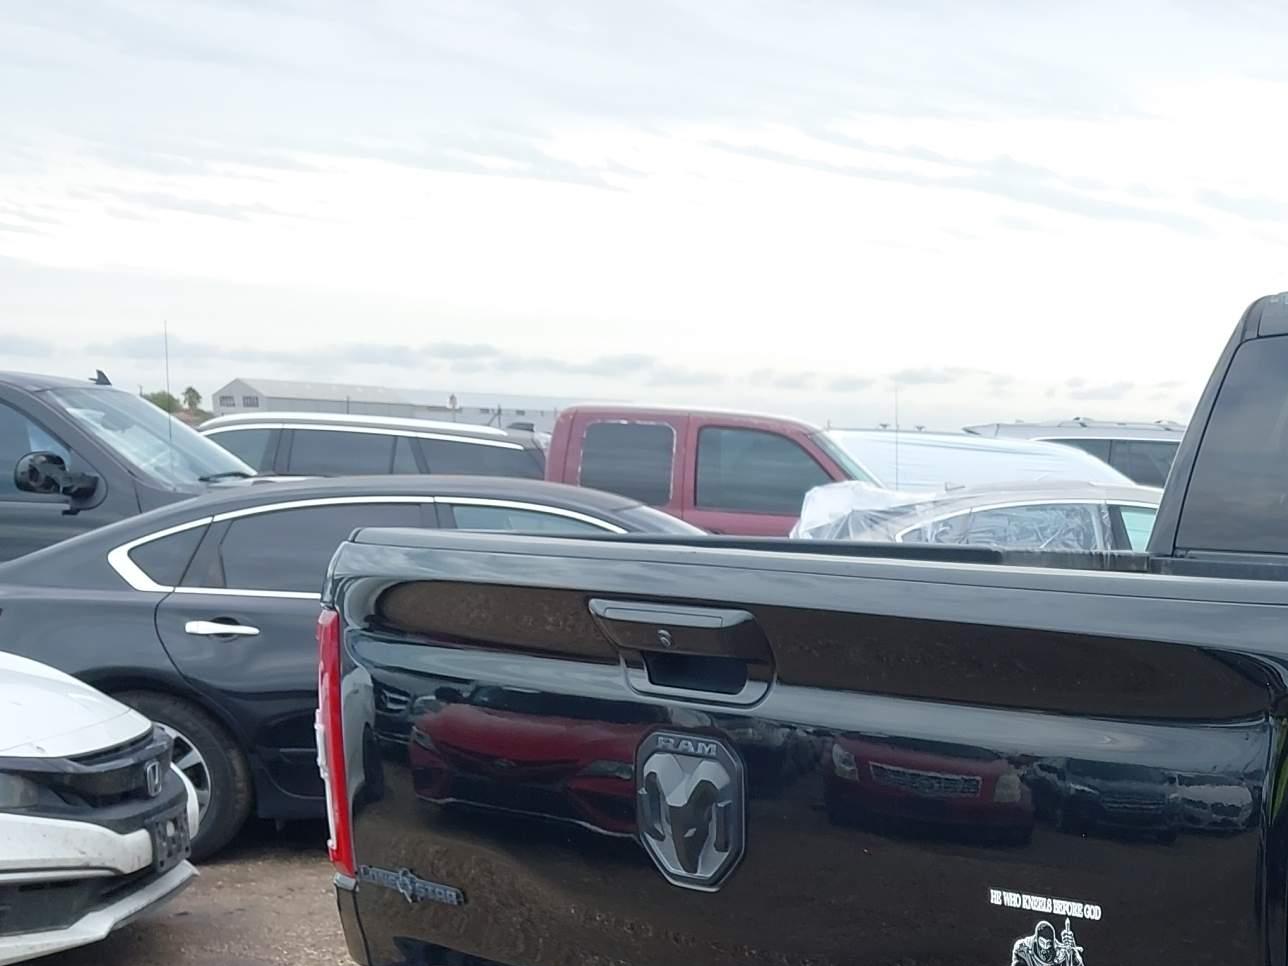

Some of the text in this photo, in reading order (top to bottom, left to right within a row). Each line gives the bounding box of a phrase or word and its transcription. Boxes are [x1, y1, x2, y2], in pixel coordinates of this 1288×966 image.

[657, 736, 717, 756] RAM
[990, 889, 1102, 920] HE WHO KNEELS BEFORE GOD
